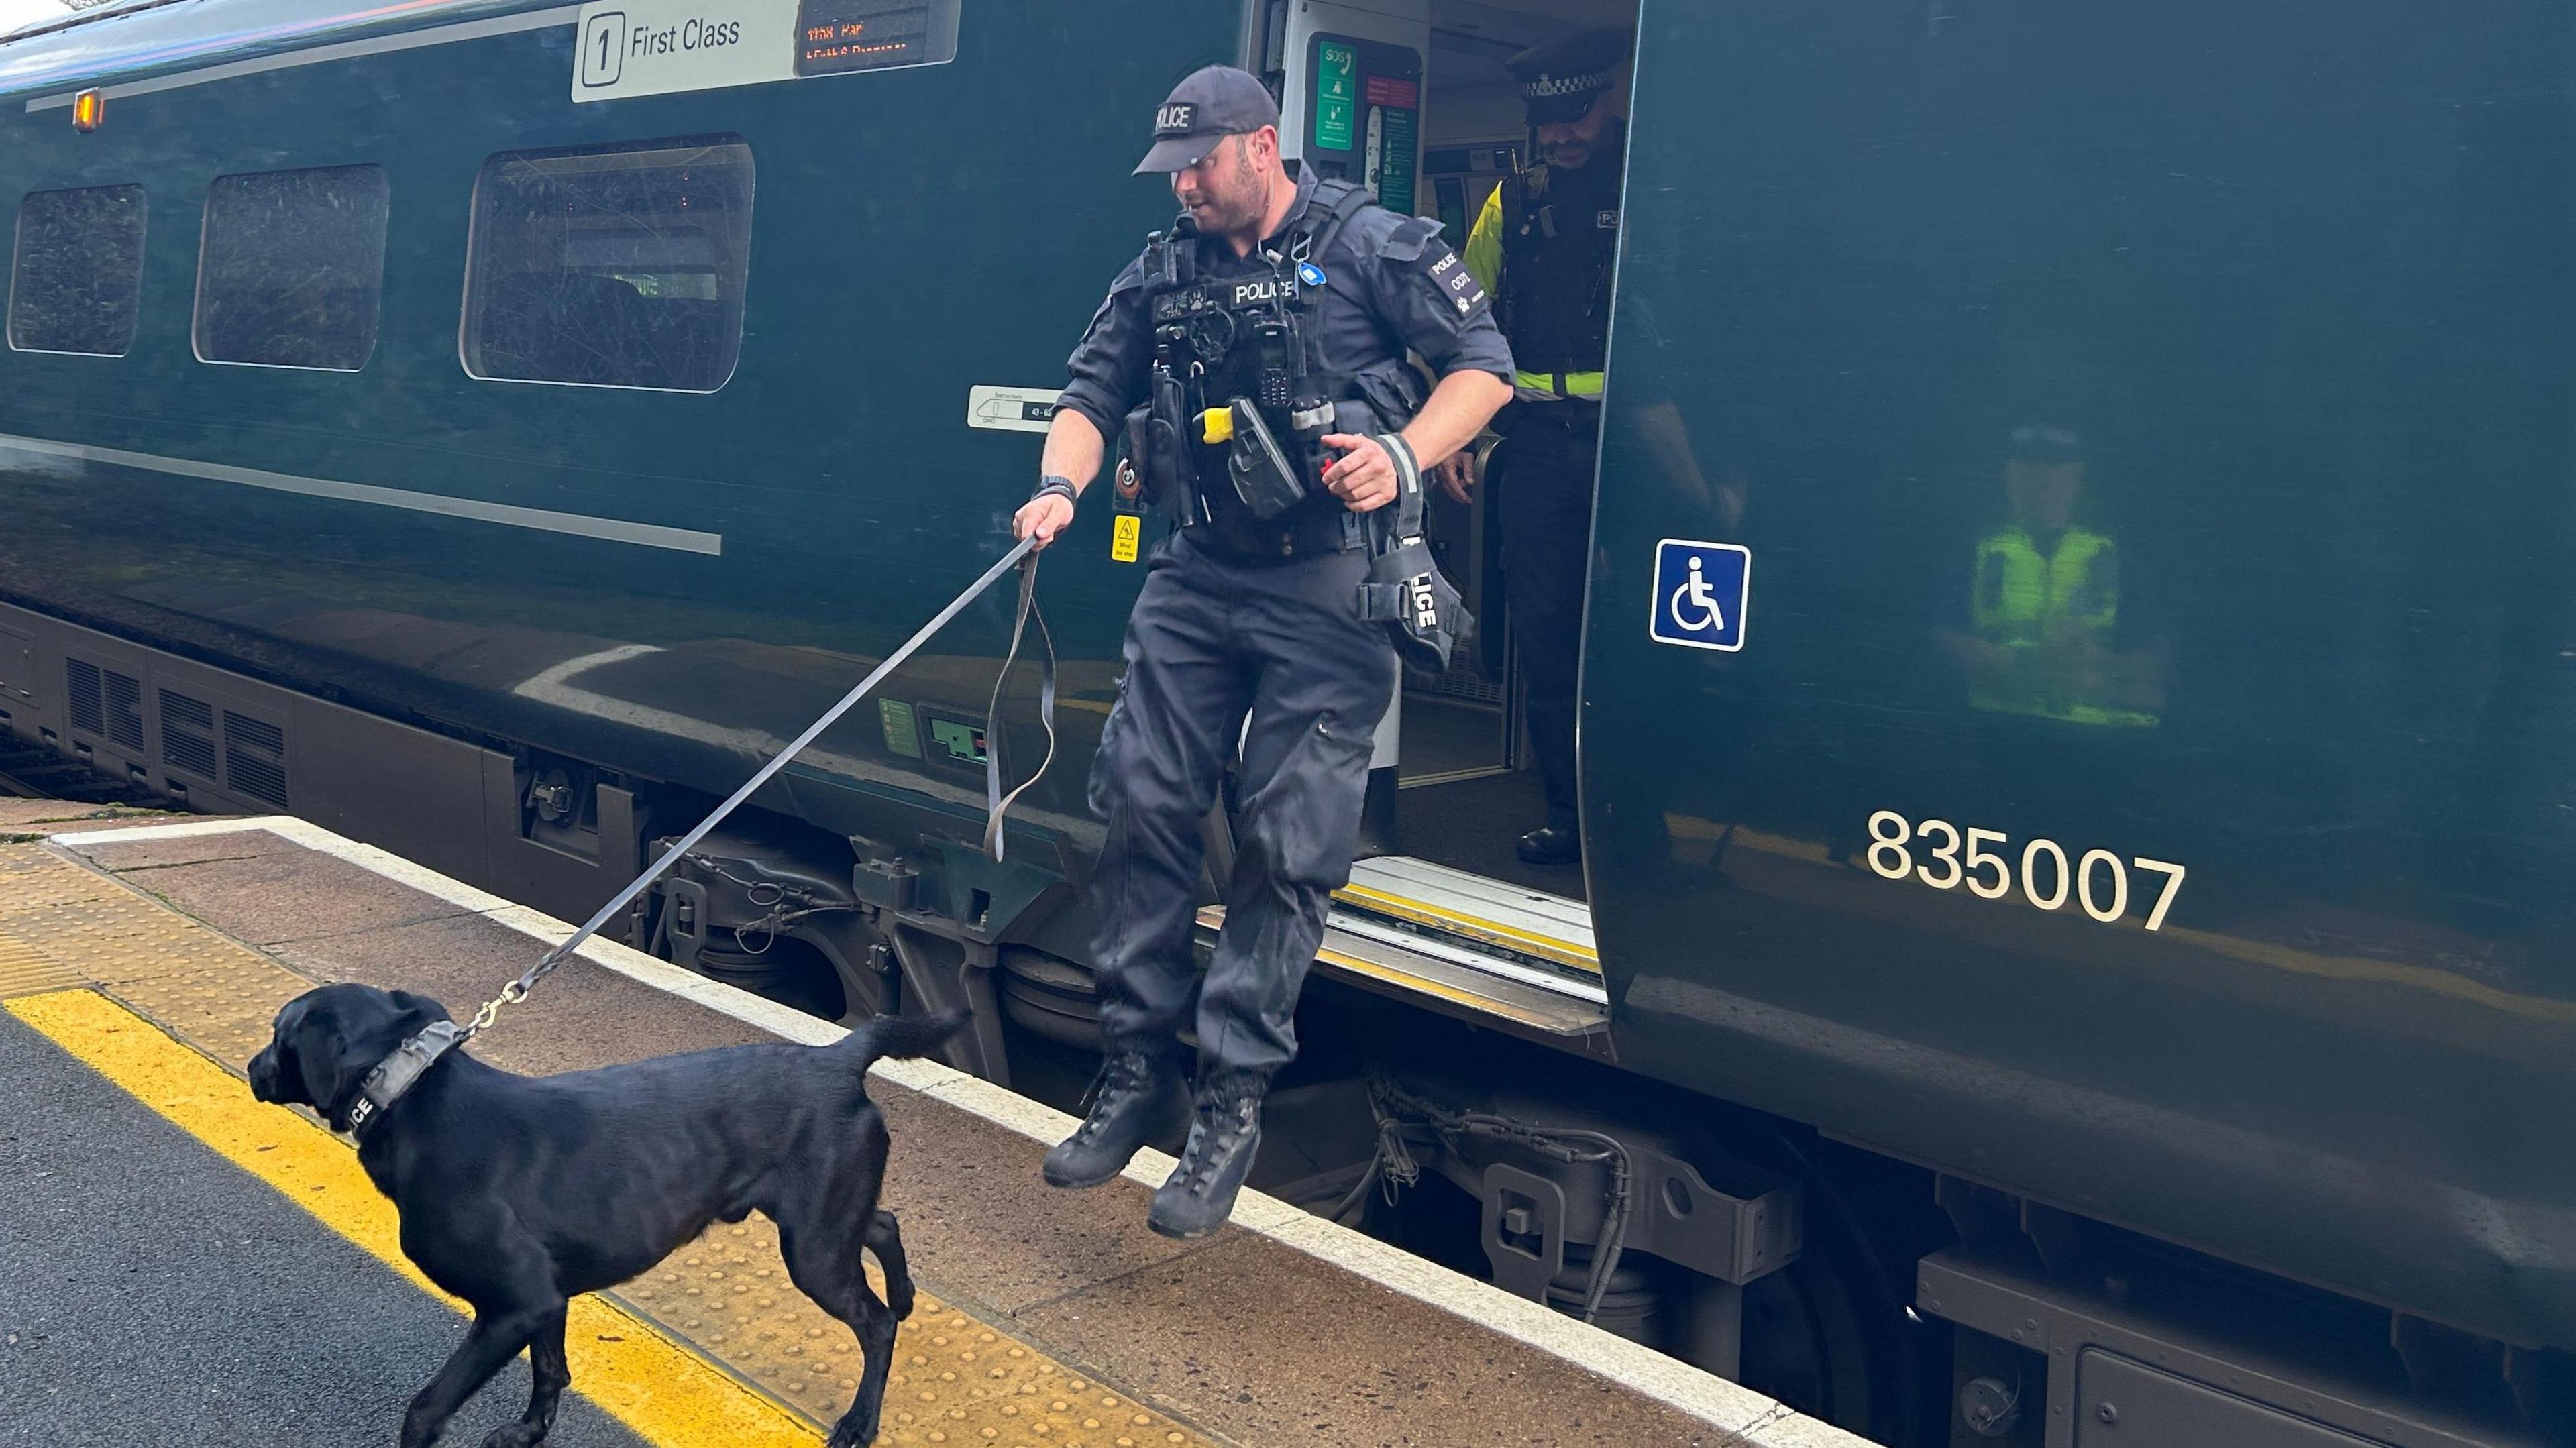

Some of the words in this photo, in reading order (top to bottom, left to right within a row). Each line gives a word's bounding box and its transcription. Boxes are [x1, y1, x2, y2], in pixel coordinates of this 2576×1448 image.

[598, 28, 609, 70] 1
[631, 25, 676, 57] First
[683, 18, 740, 50] Class
[1326, 48, 1345, 62] SOS
[1432, 252, 1457, 275] POLICE
[1236, 281, 1293, 303] POLICE
[1031, 408, 1040, 416] 43
[1868, 811, 2185, 931] 835007
